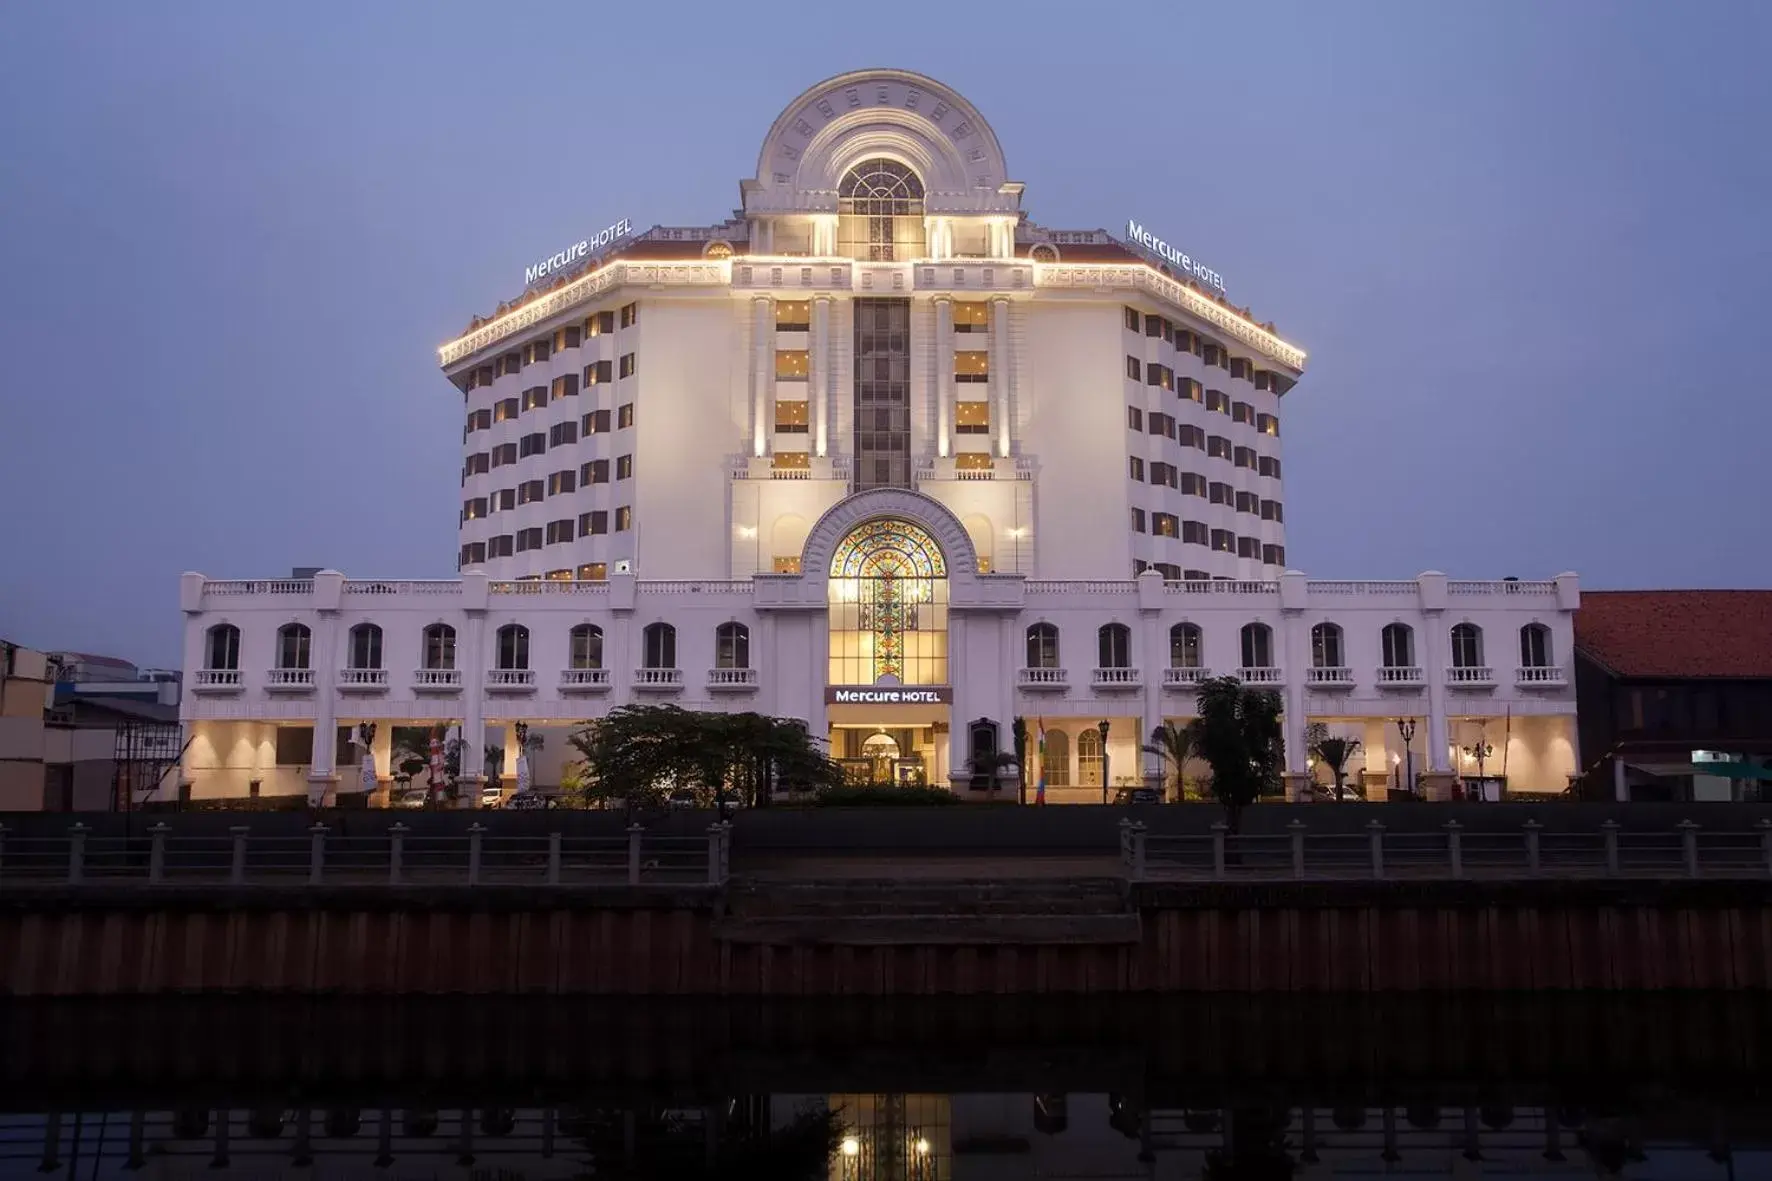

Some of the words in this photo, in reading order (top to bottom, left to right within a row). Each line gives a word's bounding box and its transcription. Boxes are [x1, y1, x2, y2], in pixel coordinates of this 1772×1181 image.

[525, 241, 587, 285] Mercure
[591, 218, 632, 250] HOTEL
[1129, 219, 1191, 270] Mercure
[1192, 260, 1226, 292] HOTEL
[836, 691, 900, 702] Mercure
[902, 692, 941, 702] HOTEL
